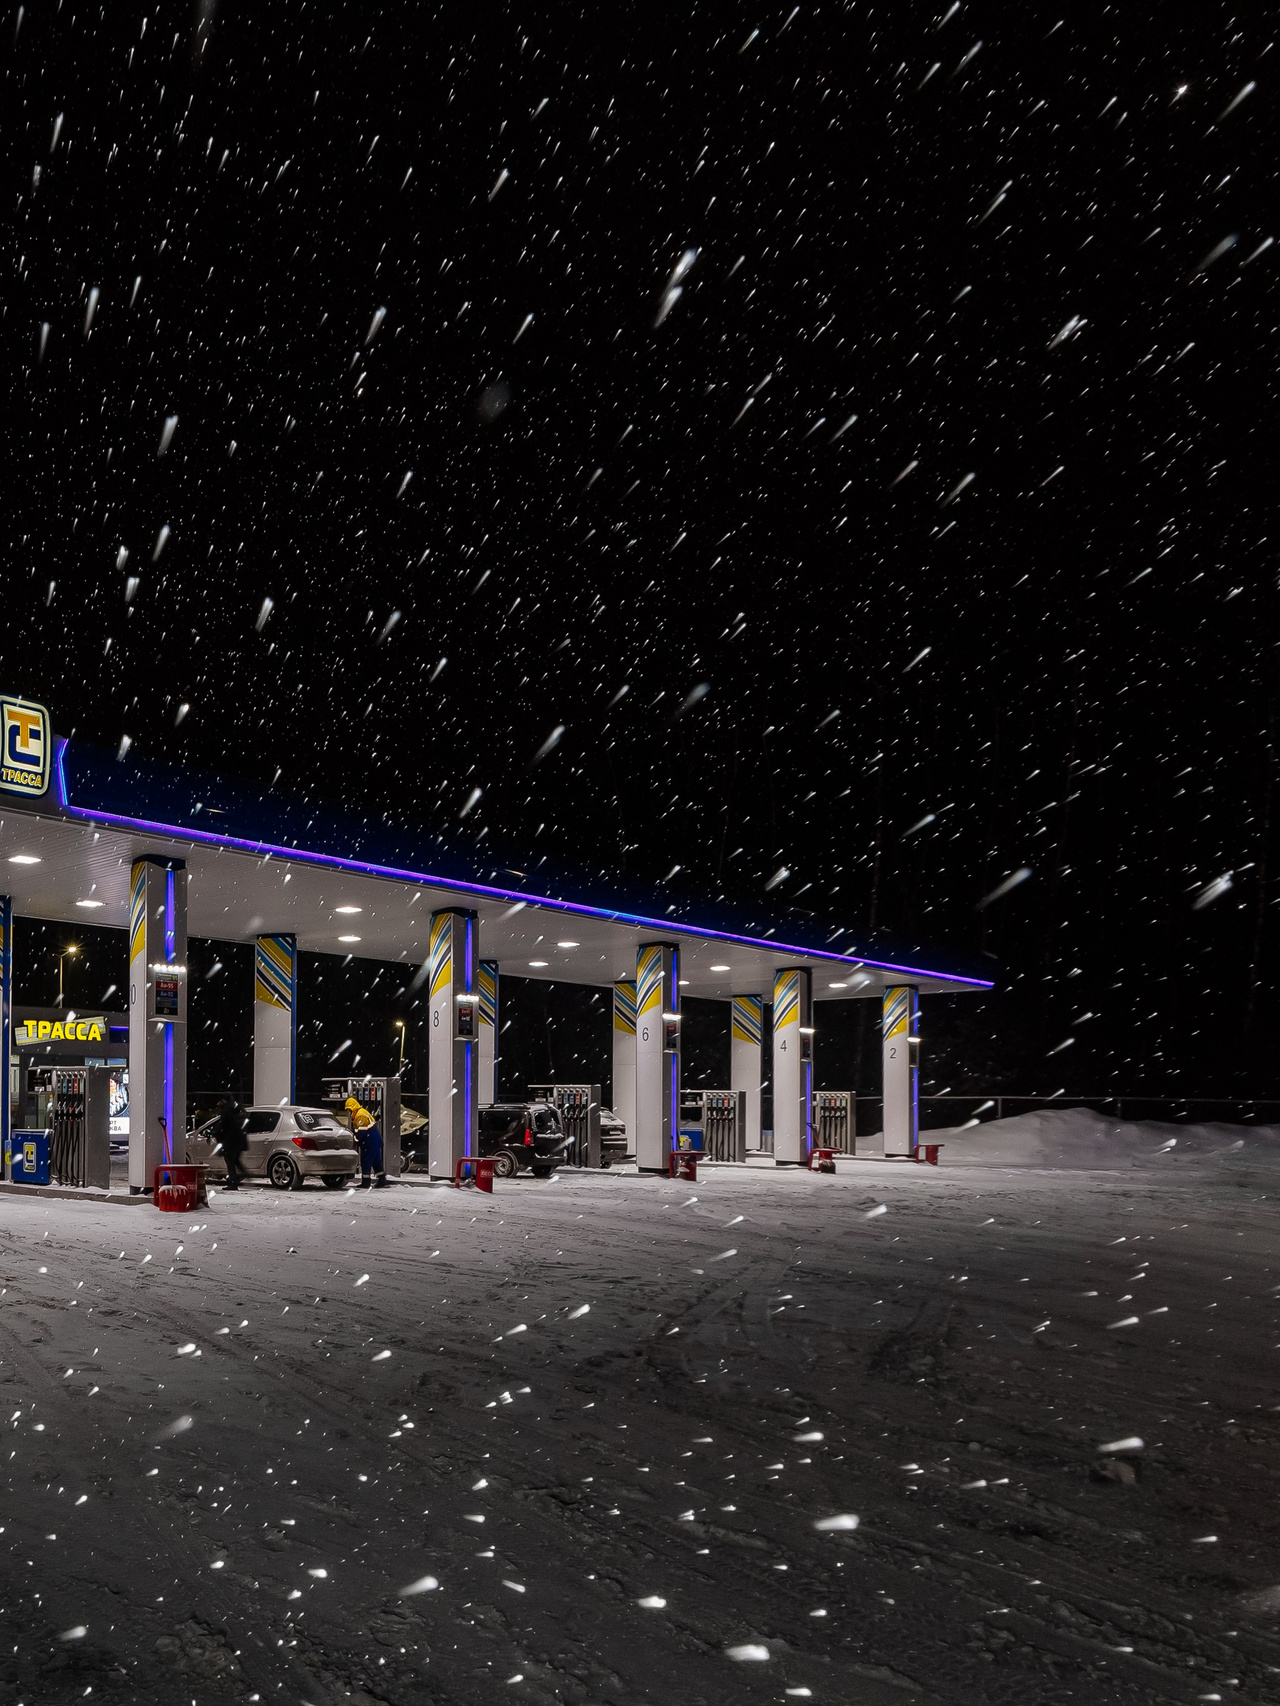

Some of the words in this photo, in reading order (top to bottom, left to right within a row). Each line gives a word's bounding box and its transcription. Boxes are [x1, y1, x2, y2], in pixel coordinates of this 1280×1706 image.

[1, 768, 42, 787] ТРАССА
[434, 1011, 439, 1027] 8
[23, 1019, 102, 1041] ТРАССА
[642, 1027, 650, 1042] 6
[780, 1040, 787, 1052] 4
[890, 1047, 896, 1059] 2
